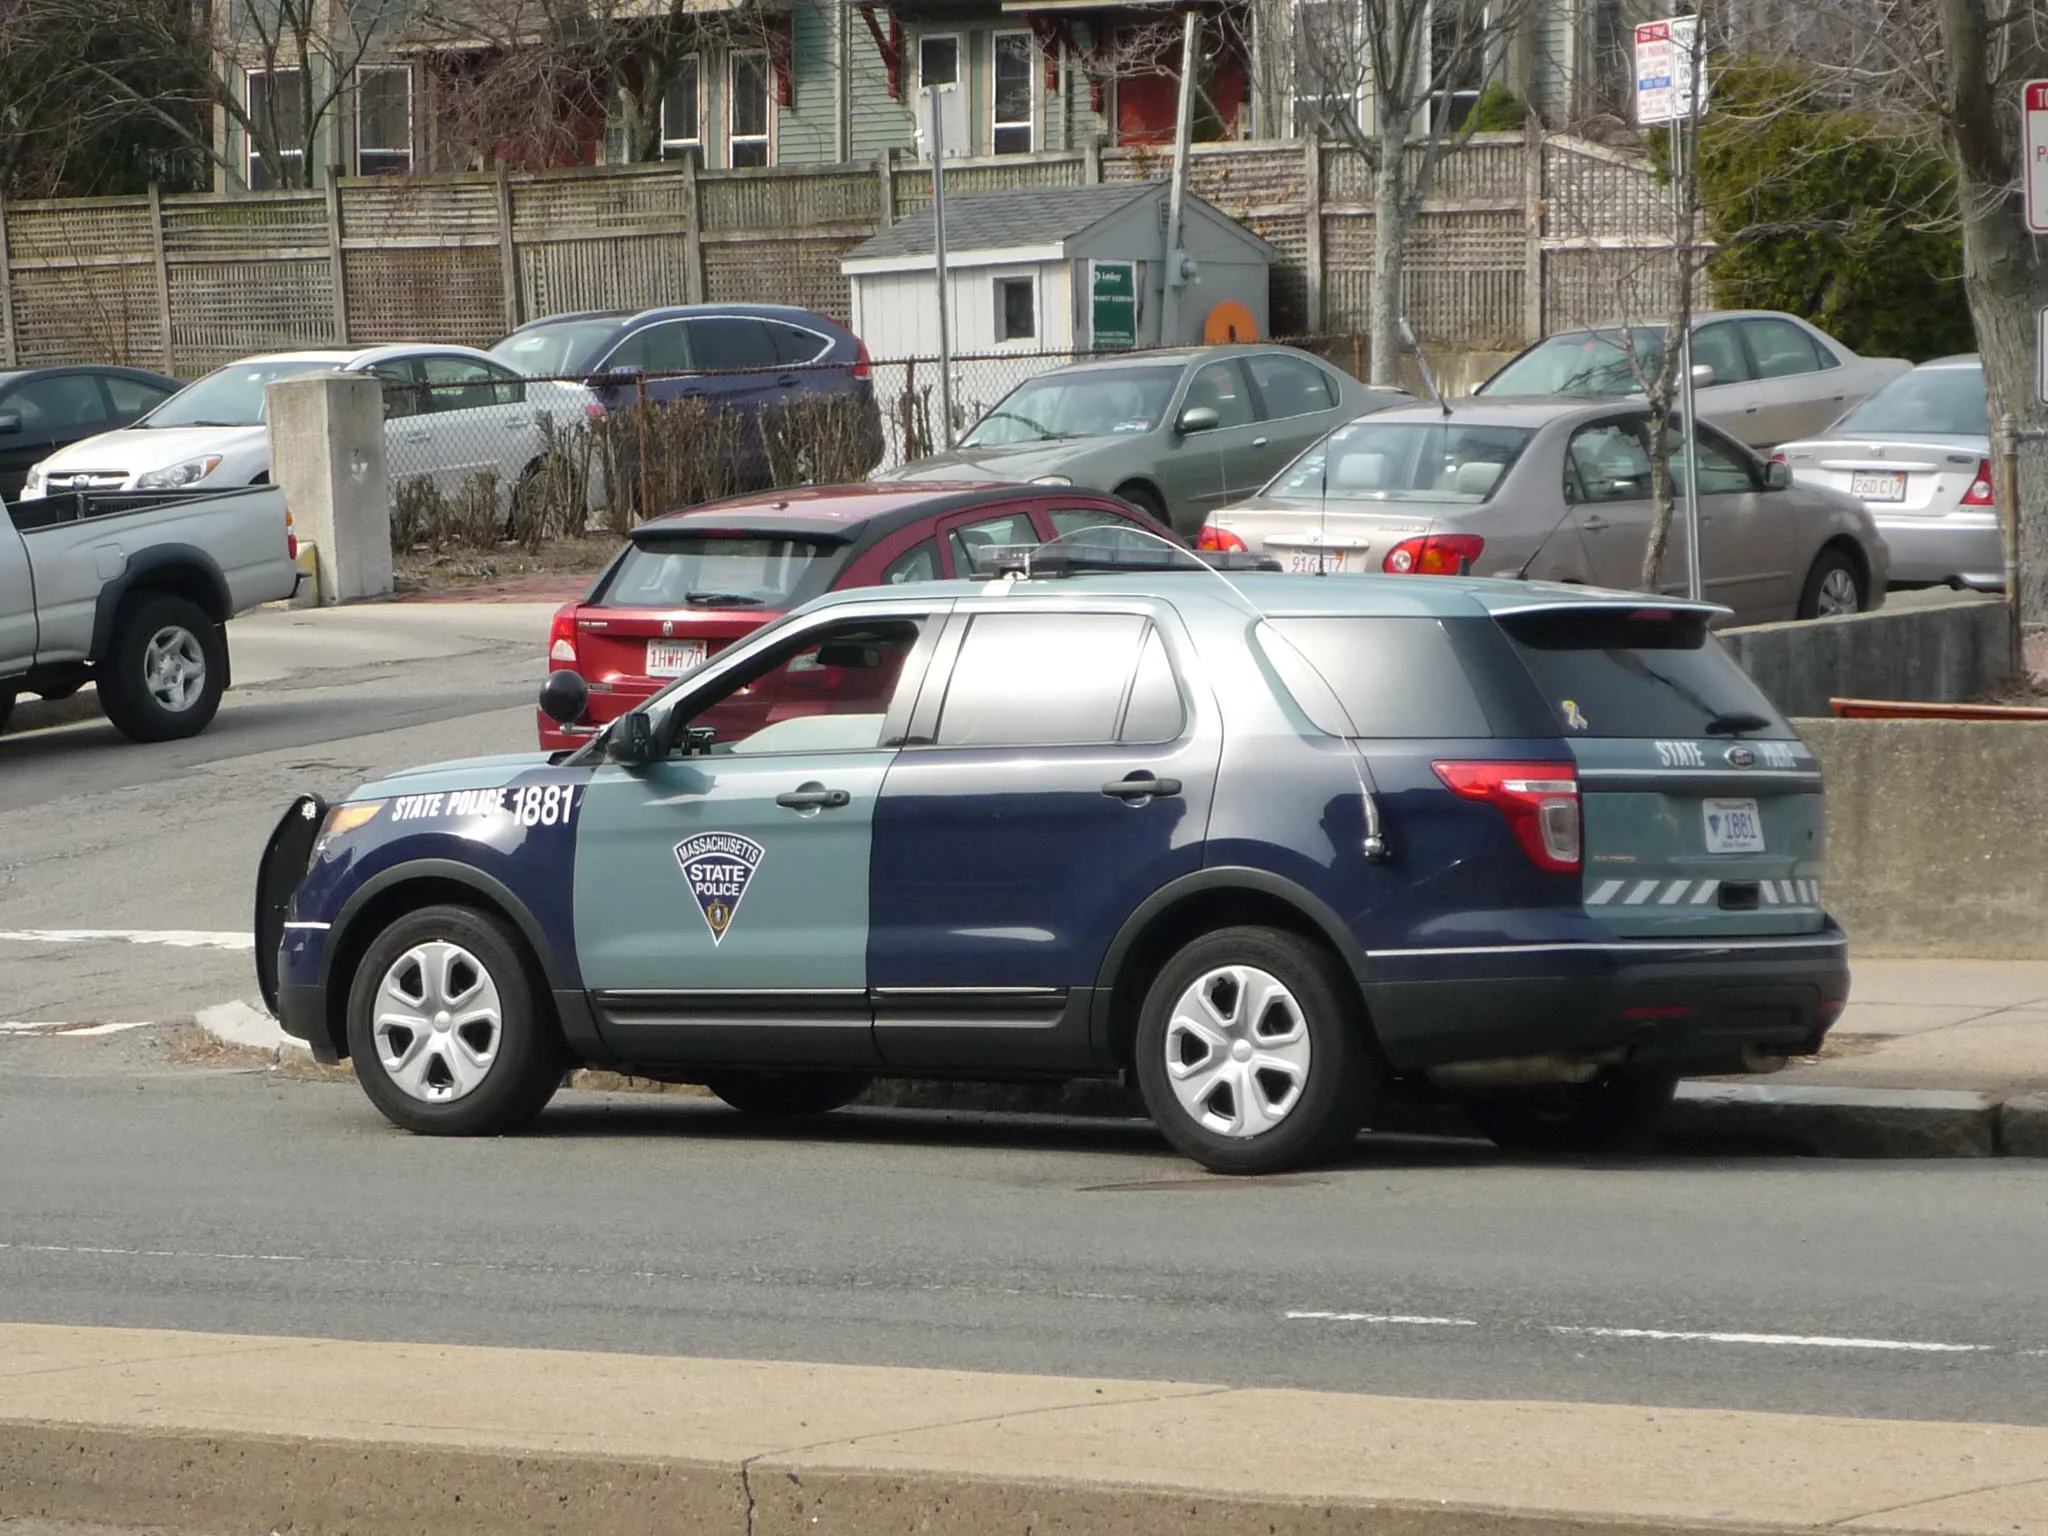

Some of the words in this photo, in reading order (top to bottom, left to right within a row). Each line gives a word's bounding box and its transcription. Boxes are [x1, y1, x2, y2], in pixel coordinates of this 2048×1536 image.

[1654, 741, 1706, 767] STATE
[391, 792, 442, 822] STATE
[444, 788, 508, 816] POLICE
[512, 784, 576, 827] 1881
[1724, 812, 1758, 839] 1881
[678, 836, 759, 863] MASSACHUSETTS
[690, 864, 746, 881] STATE
[695, 882, 740, 896] POLICE
